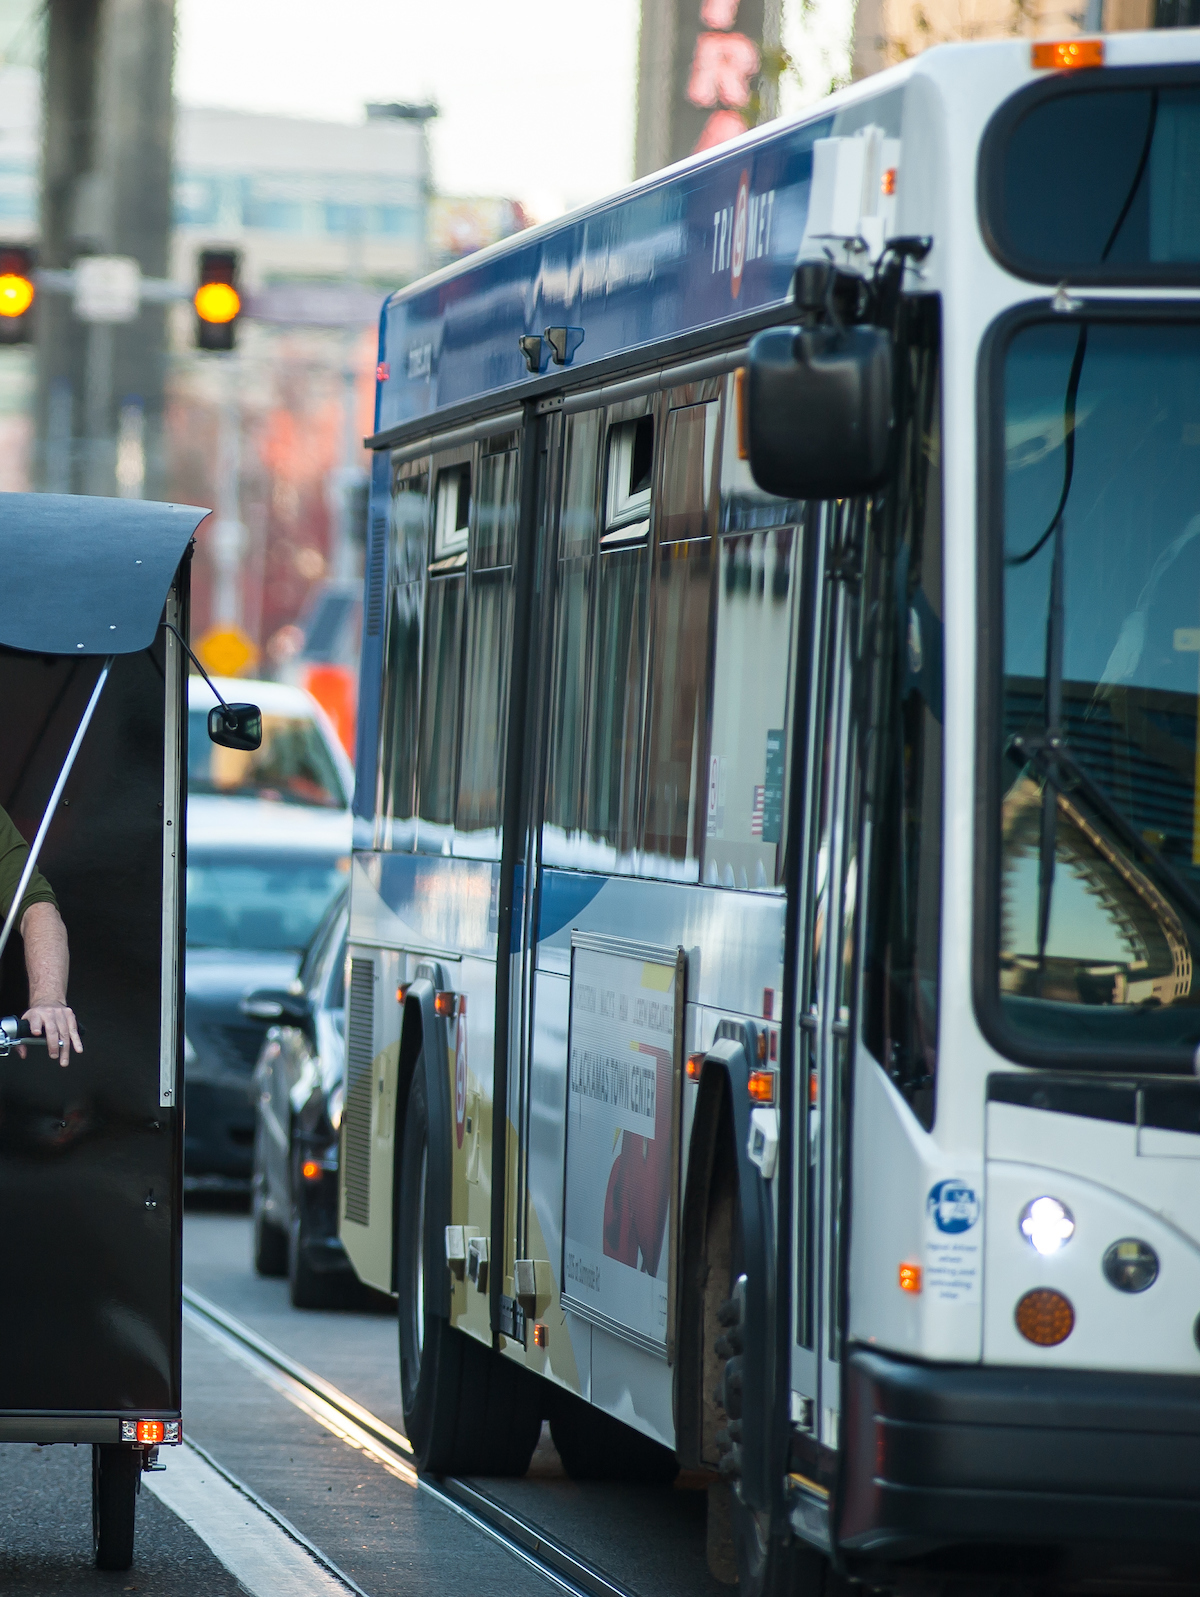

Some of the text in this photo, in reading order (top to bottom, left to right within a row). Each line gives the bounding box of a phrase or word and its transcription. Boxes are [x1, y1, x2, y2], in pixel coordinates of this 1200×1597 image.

[571, 1047, 655, 1119] CLACKAMAS TOWN CENTER
